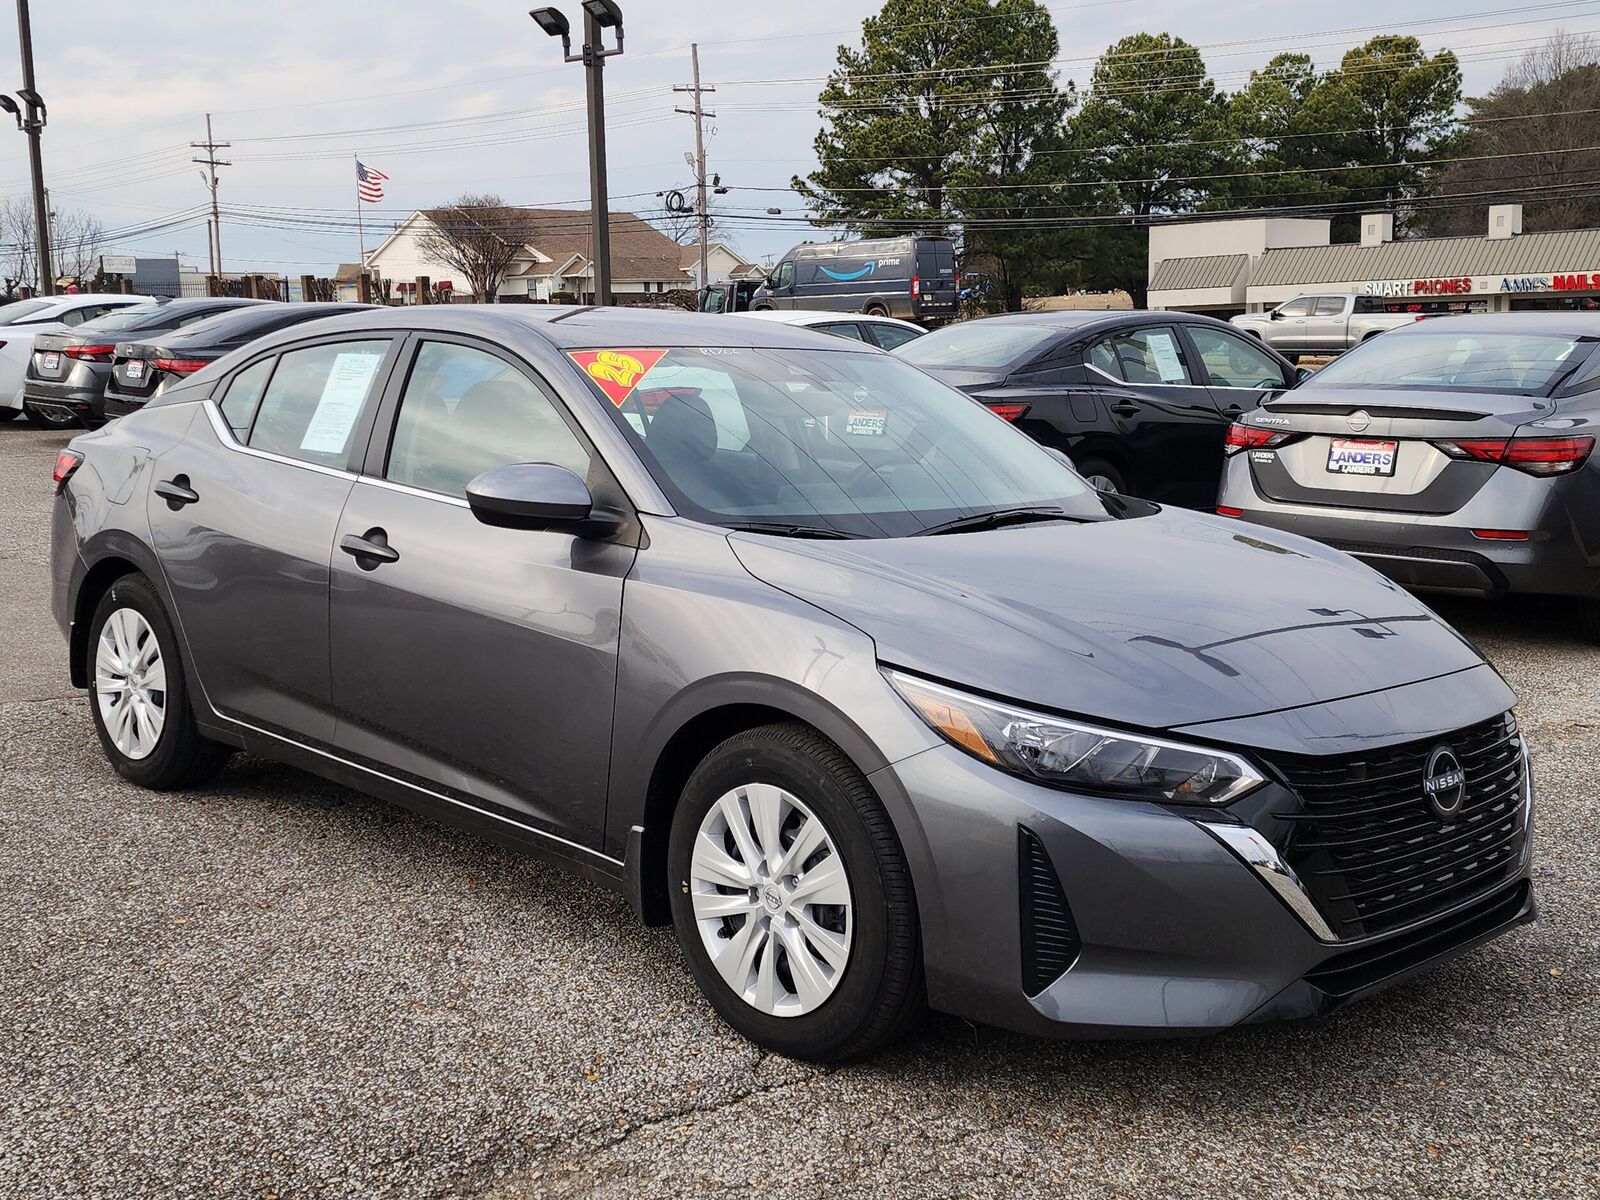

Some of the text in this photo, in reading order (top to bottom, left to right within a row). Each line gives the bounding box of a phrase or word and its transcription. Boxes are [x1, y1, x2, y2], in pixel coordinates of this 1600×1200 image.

[878, 258, 900, 268] prime
[1365, 278, 1472, 296] SMART PHONES
[1500, 274, 1600, 292] AMY'S NAILS
[588, 351, 644, 387] 25
[1255, 417, 1290, 425] SENTRA
[1330, 450, 1391, 466] LANDERS
[1342, 465, 1376, 474] LANDERS
[1426, 772, 1464, 792] NISSAN
